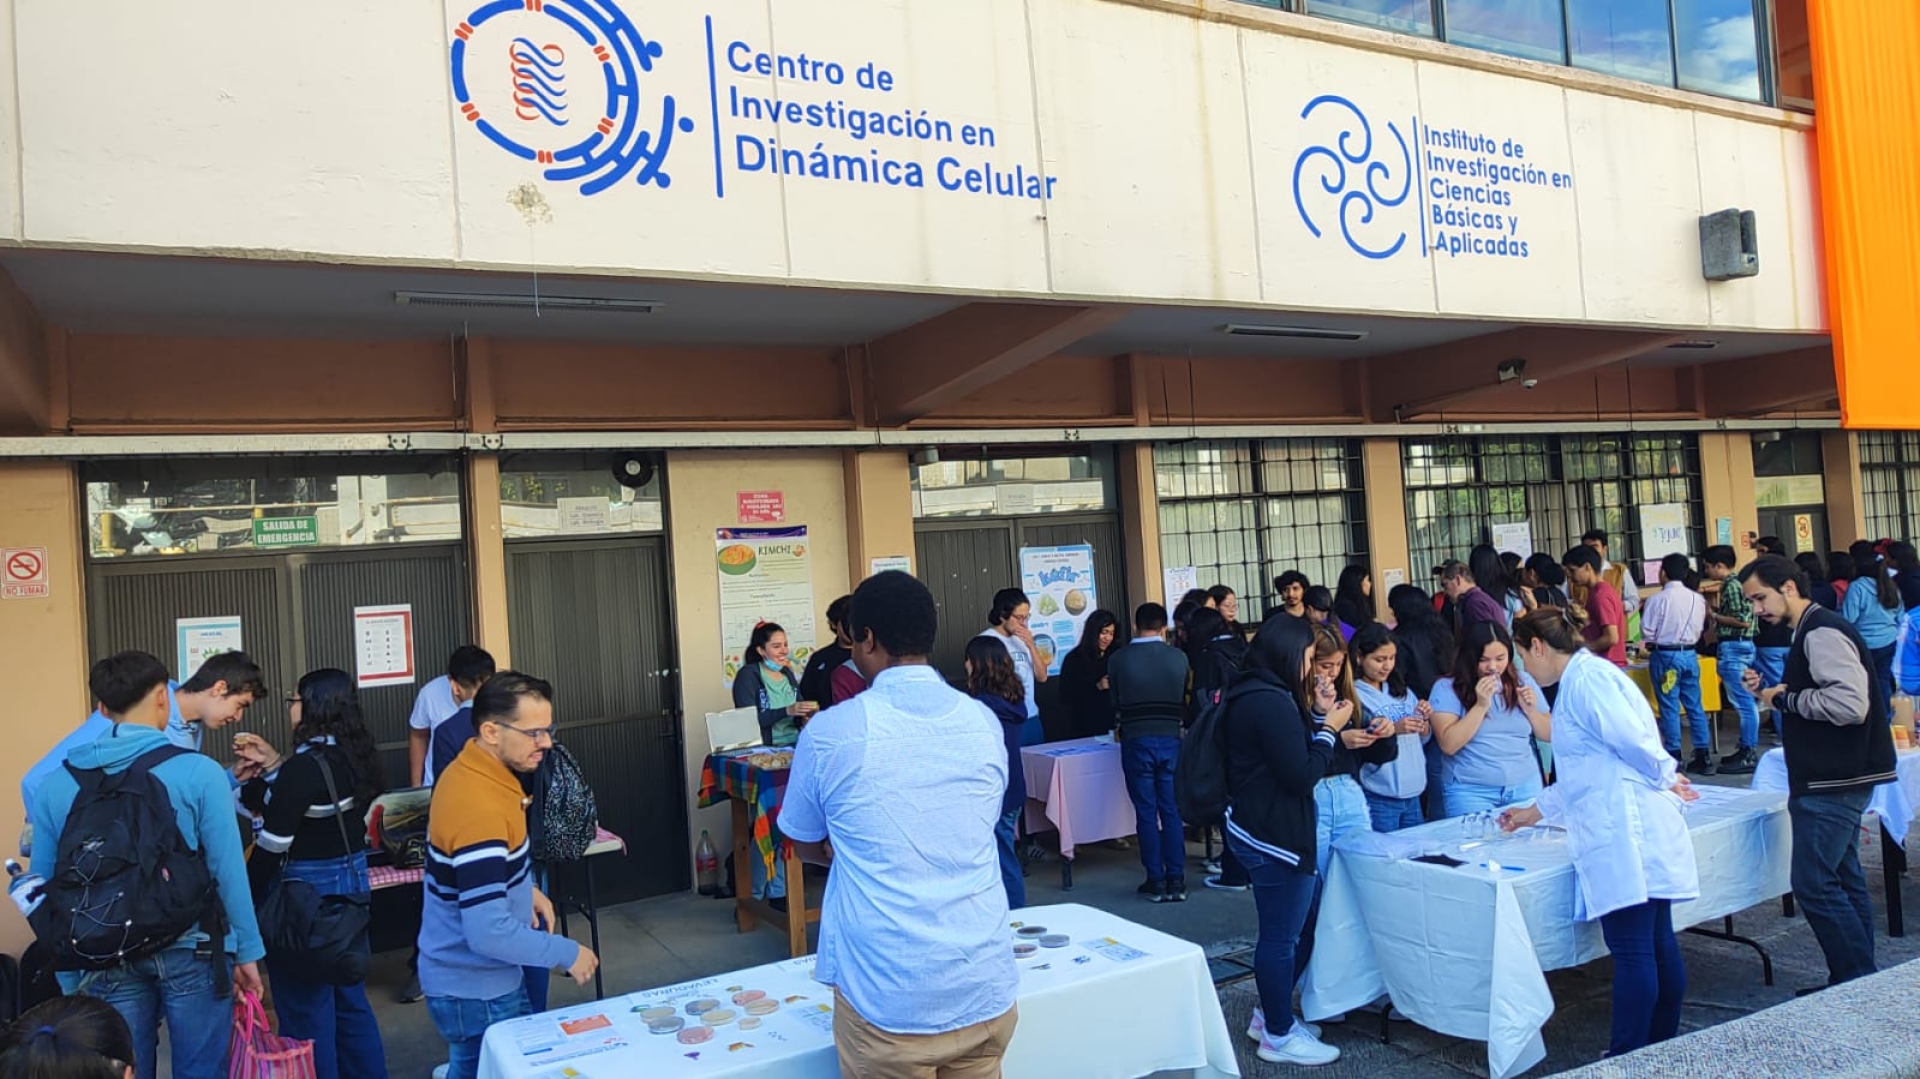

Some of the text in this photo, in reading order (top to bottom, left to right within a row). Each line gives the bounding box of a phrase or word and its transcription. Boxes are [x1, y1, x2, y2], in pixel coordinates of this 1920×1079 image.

[726, 40, 894, 93] Centro de
[729, 85, 996, 147] Investigación en
[1423, 125, 1524, 159] Instituto de
[735, 133, 1057, 200] Dinámica Celular
[1426, 151, 1572, 188] Investigación en
[1429, 177, 1511, 207] Ciencias
[1432, 203, 1518, 235] Básicas y
[1435, 231, 1529, 258] Aplicadas
[257, 532, 316, 544] EMERGENCIA
[262, 520, 308, 531] SALIDA DE
[758, 545, 791, 556] KIMCHI
[5, 586, 18, 596] NO
